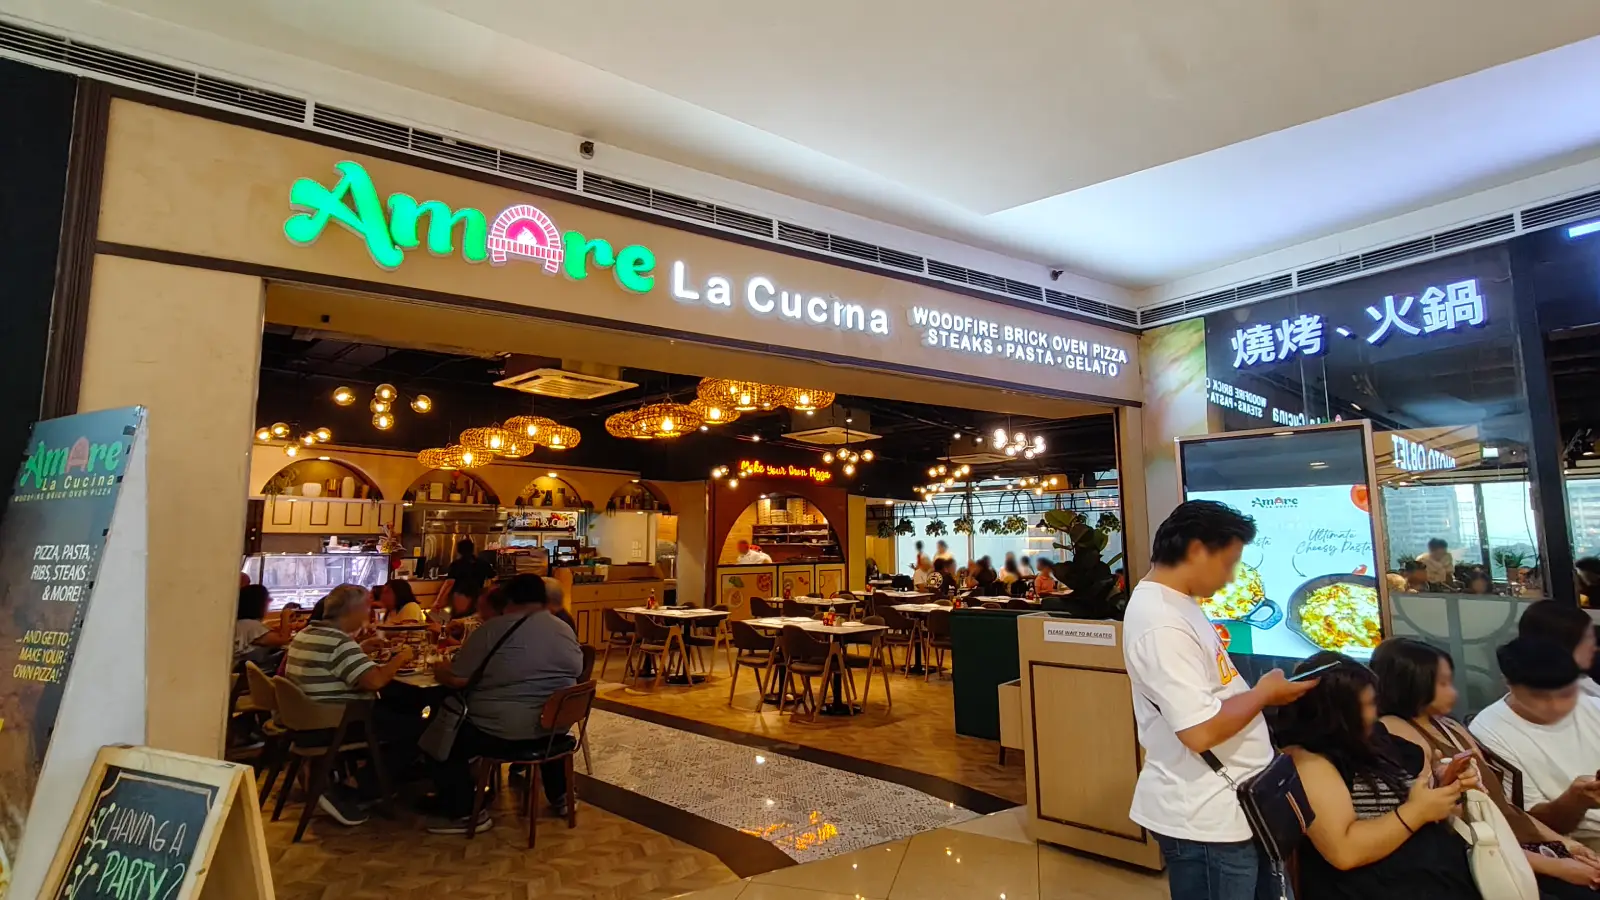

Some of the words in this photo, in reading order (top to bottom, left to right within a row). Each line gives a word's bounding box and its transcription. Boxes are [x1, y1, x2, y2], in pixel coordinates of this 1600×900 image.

[673, 260, 732, 306] La
[747, 276, 889, 335] Cucina
[913, 306, 999, 339] WOODFIRE
[1004, 326, 1048, 348] BRICK
[1052, 335, 1088, 356] OVEN
[1093, 345, 1128, 364] PIZZA
[928, 328, 993, 355] STEAKS
[1006, 344, 1054, 366] PASTA
[1066, 355, 1118, 376] GELATO
[42, 478, 57, 491] La
[63, 473, 115, 489] Cucina
[1308, 528, 1356, 543] Ultimate
[33, 545, 60, 562] PIZZA,
[61, 544, 91, 561] PASTA,
[31, 564, 51, 582] RIBS,
[52, 564, 87, 581] STEAKS
[42, 585, 50, 601] &
[50, 586, 81, 602] MORE!
[57, 632, 69, 646] TO
[19, 647, 42, 662] MAKE
[42, 649, 64, 664] YOUR
[106, 807, 170, 852] HAVING
[168, 822, 187, 857] A
